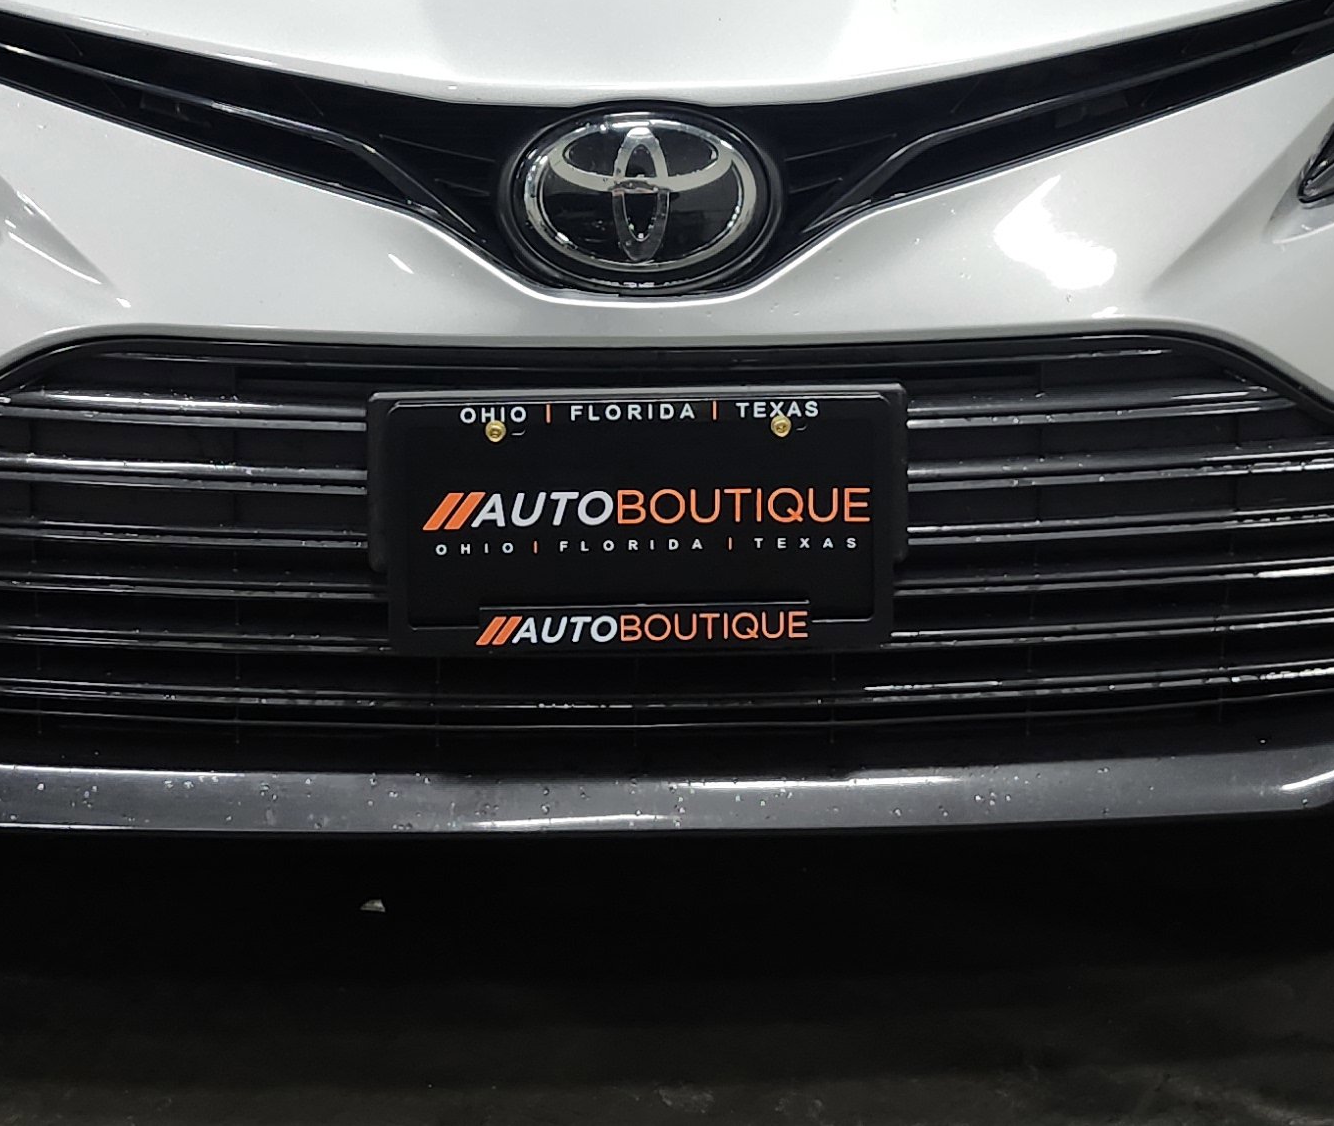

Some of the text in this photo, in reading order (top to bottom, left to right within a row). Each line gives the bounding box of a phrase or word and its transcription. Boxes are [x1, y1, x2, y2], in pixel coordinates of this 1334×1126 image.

[459, 400, 819, 424] OHIO FLORIDA TEXAS
[435, 537, 857, 555] OHIO FLORIDA TEXAS
